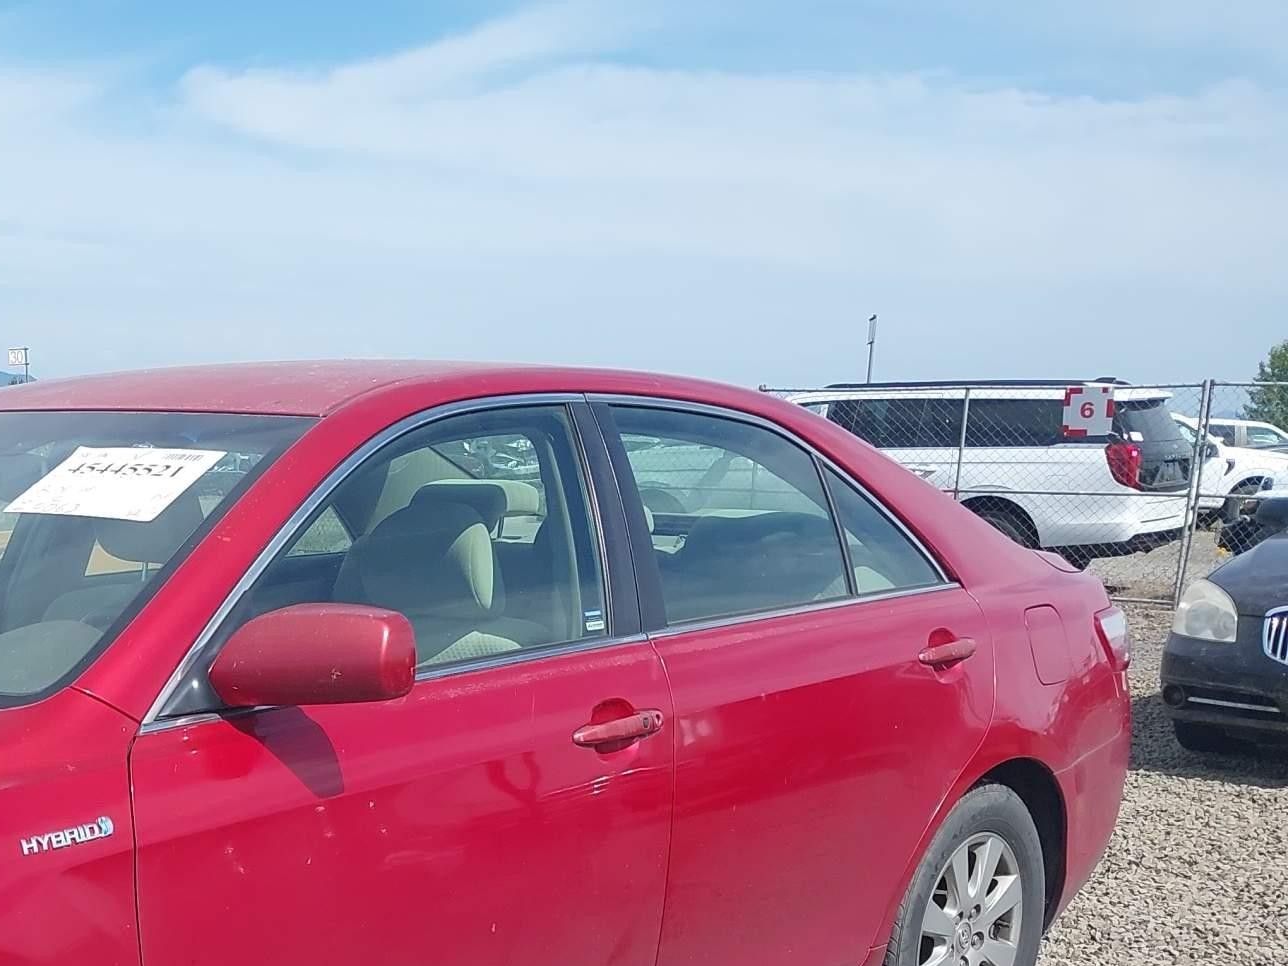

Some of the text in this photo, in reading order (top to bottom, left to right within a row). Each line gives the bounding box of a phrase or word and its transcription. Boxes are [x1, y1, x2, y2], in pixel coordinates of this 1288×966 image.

[1080, 401, 1095, 419] 6
[67, 462, 184, 478] 45445521
[20, 822, 101, 855] HYBRID
